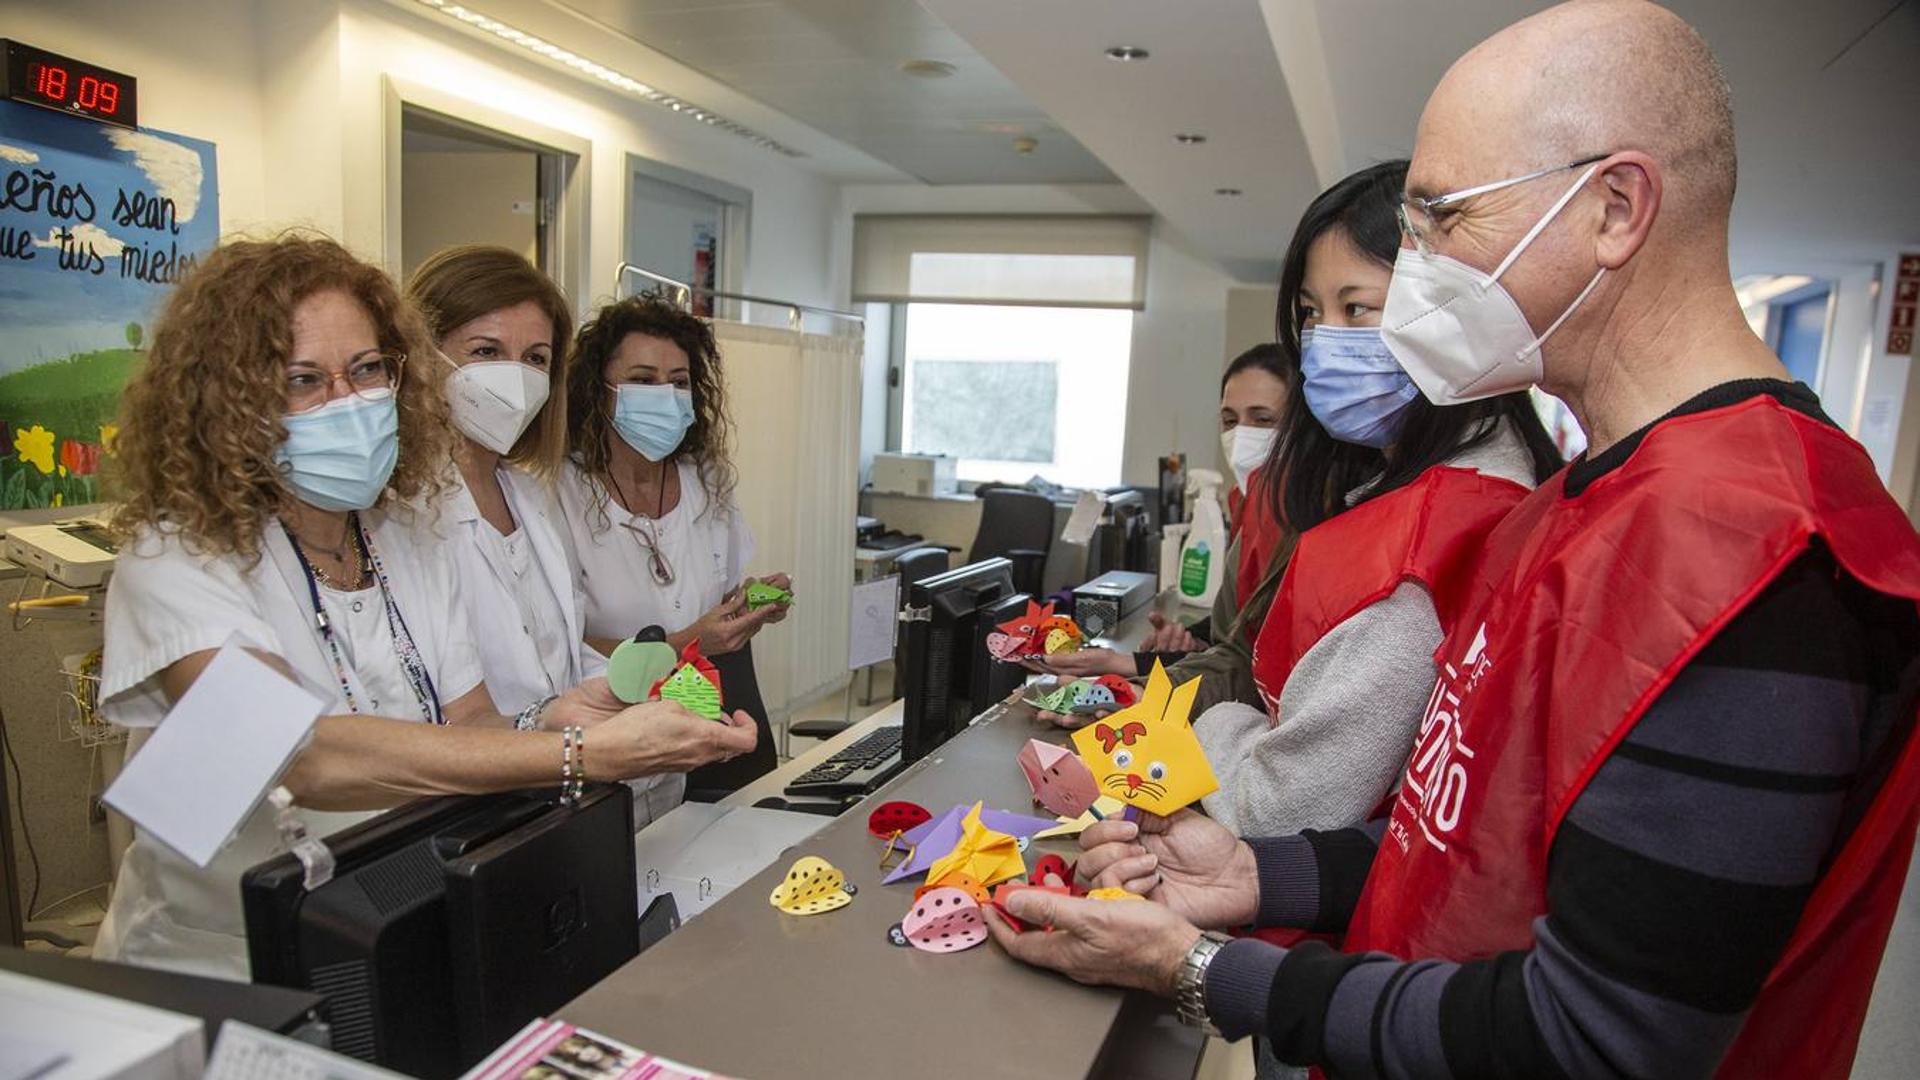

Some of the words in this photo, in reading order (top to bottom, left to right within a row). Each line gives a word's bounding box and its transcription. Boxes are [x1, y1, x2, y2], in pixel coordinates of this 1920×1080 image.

[0, 168, 96, 222] eños
[112, 188, 180, 235] sean
[0, 227, 35, 260] ue
[55, 226, 105, 275] tus
